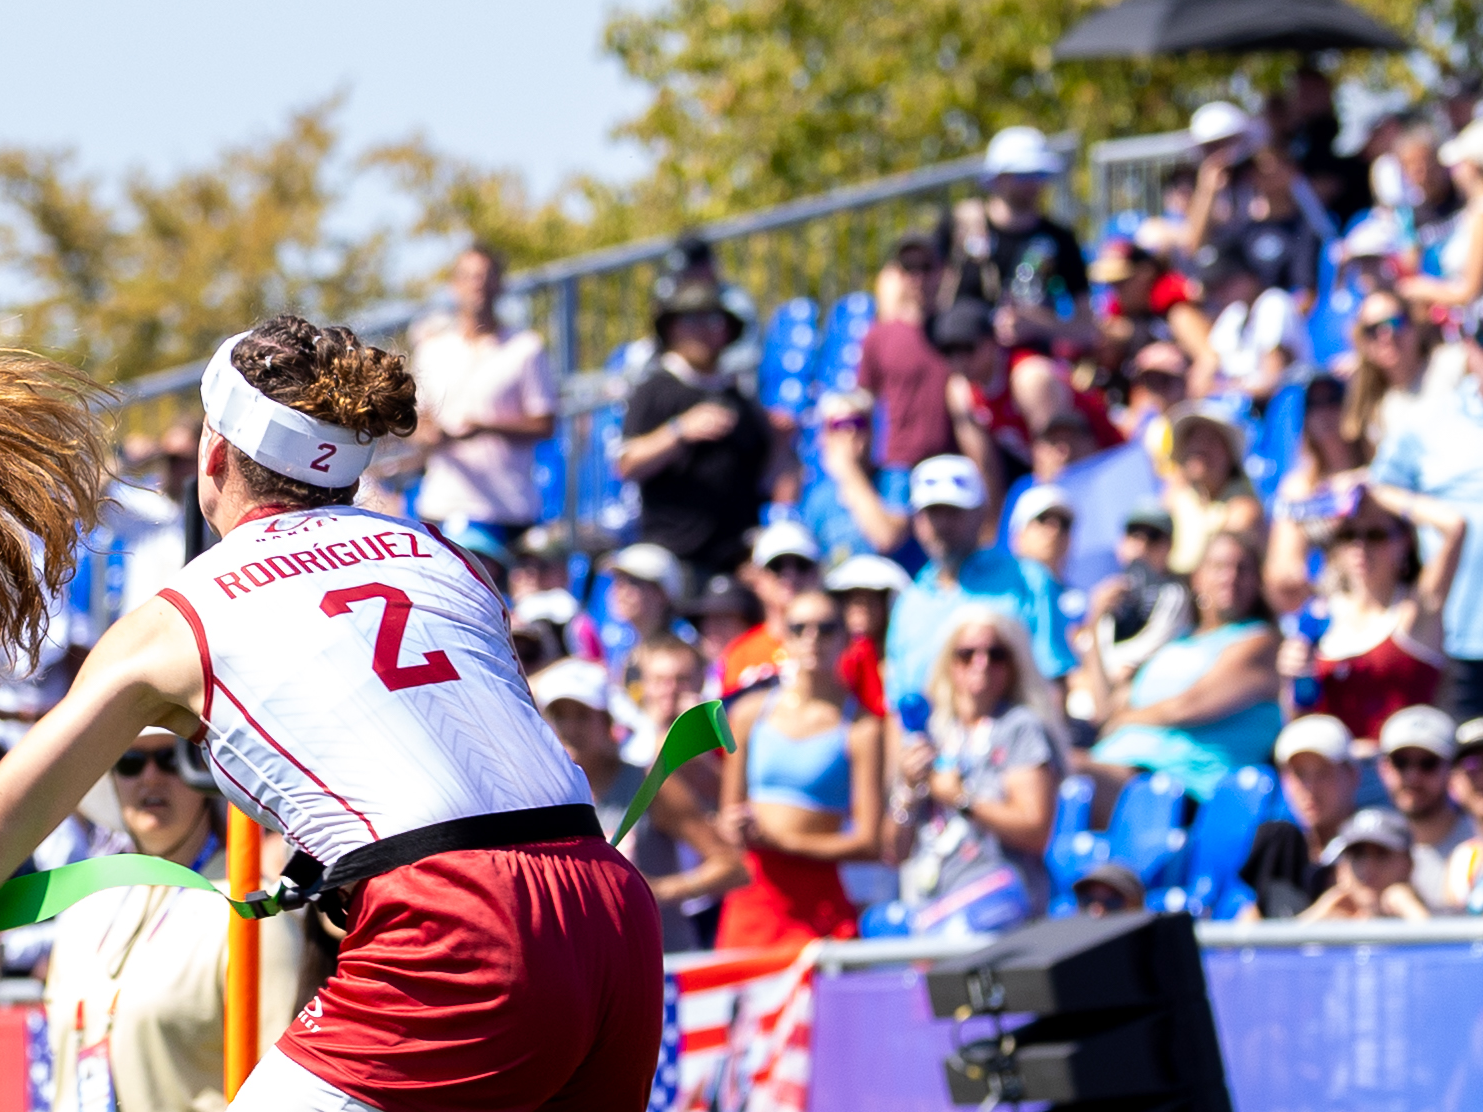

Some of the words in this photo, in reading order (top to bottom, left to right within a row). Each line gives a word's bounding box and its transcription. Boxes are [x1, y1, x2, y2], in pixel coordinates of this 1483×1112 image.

[310, 443, 337, 473] 2
[214, 532, 432, 600] RODRÍGUEZ
[319, 581, 461, 692] 2
